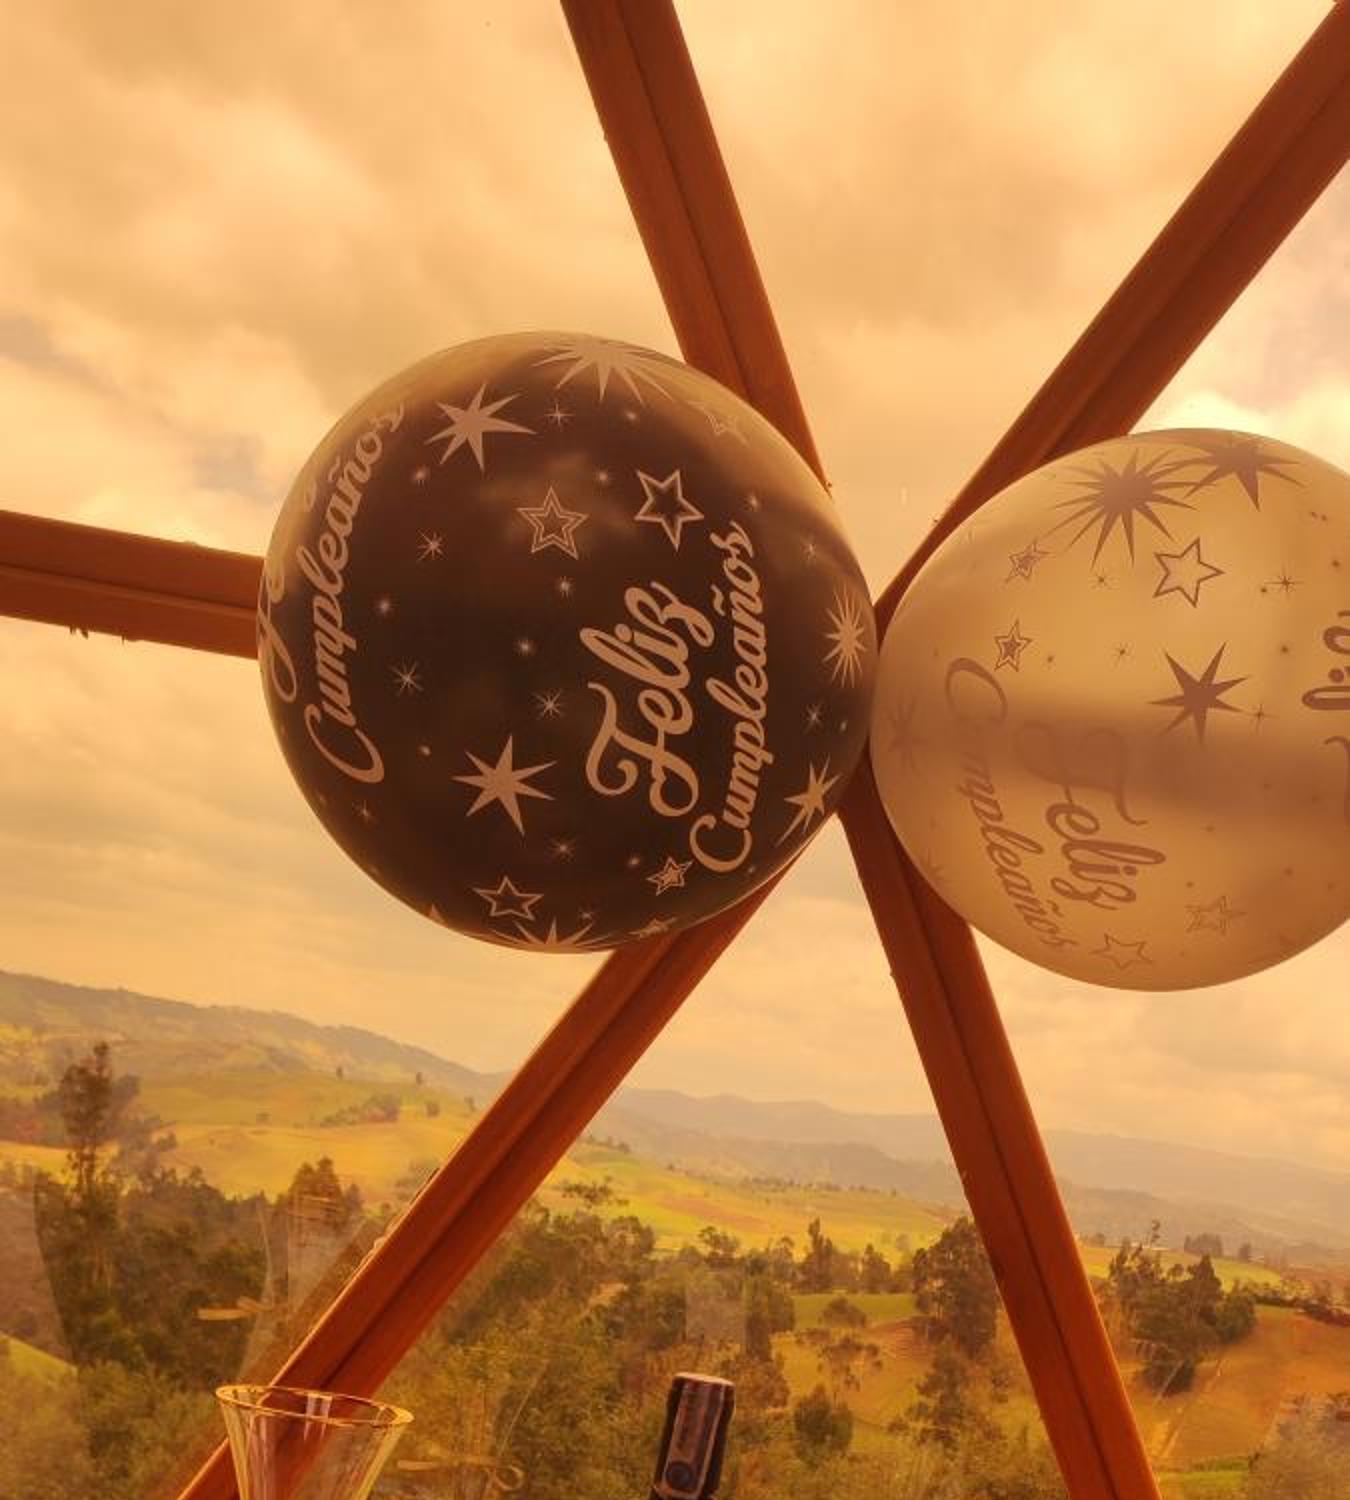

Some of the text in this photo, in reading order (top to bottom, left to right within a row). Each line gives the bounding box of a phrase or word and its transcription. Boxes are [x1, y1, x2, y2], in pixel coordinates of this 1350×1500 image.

[296, 400, 404, 784] Cumpleaños
[580, 582, 714, 817] Feliz
[691, 522, 774, 872] Cumpleaños
[945, 657, 1077, 946] Cmpleaños
[1014, 720, 1166, 910] Feliz
